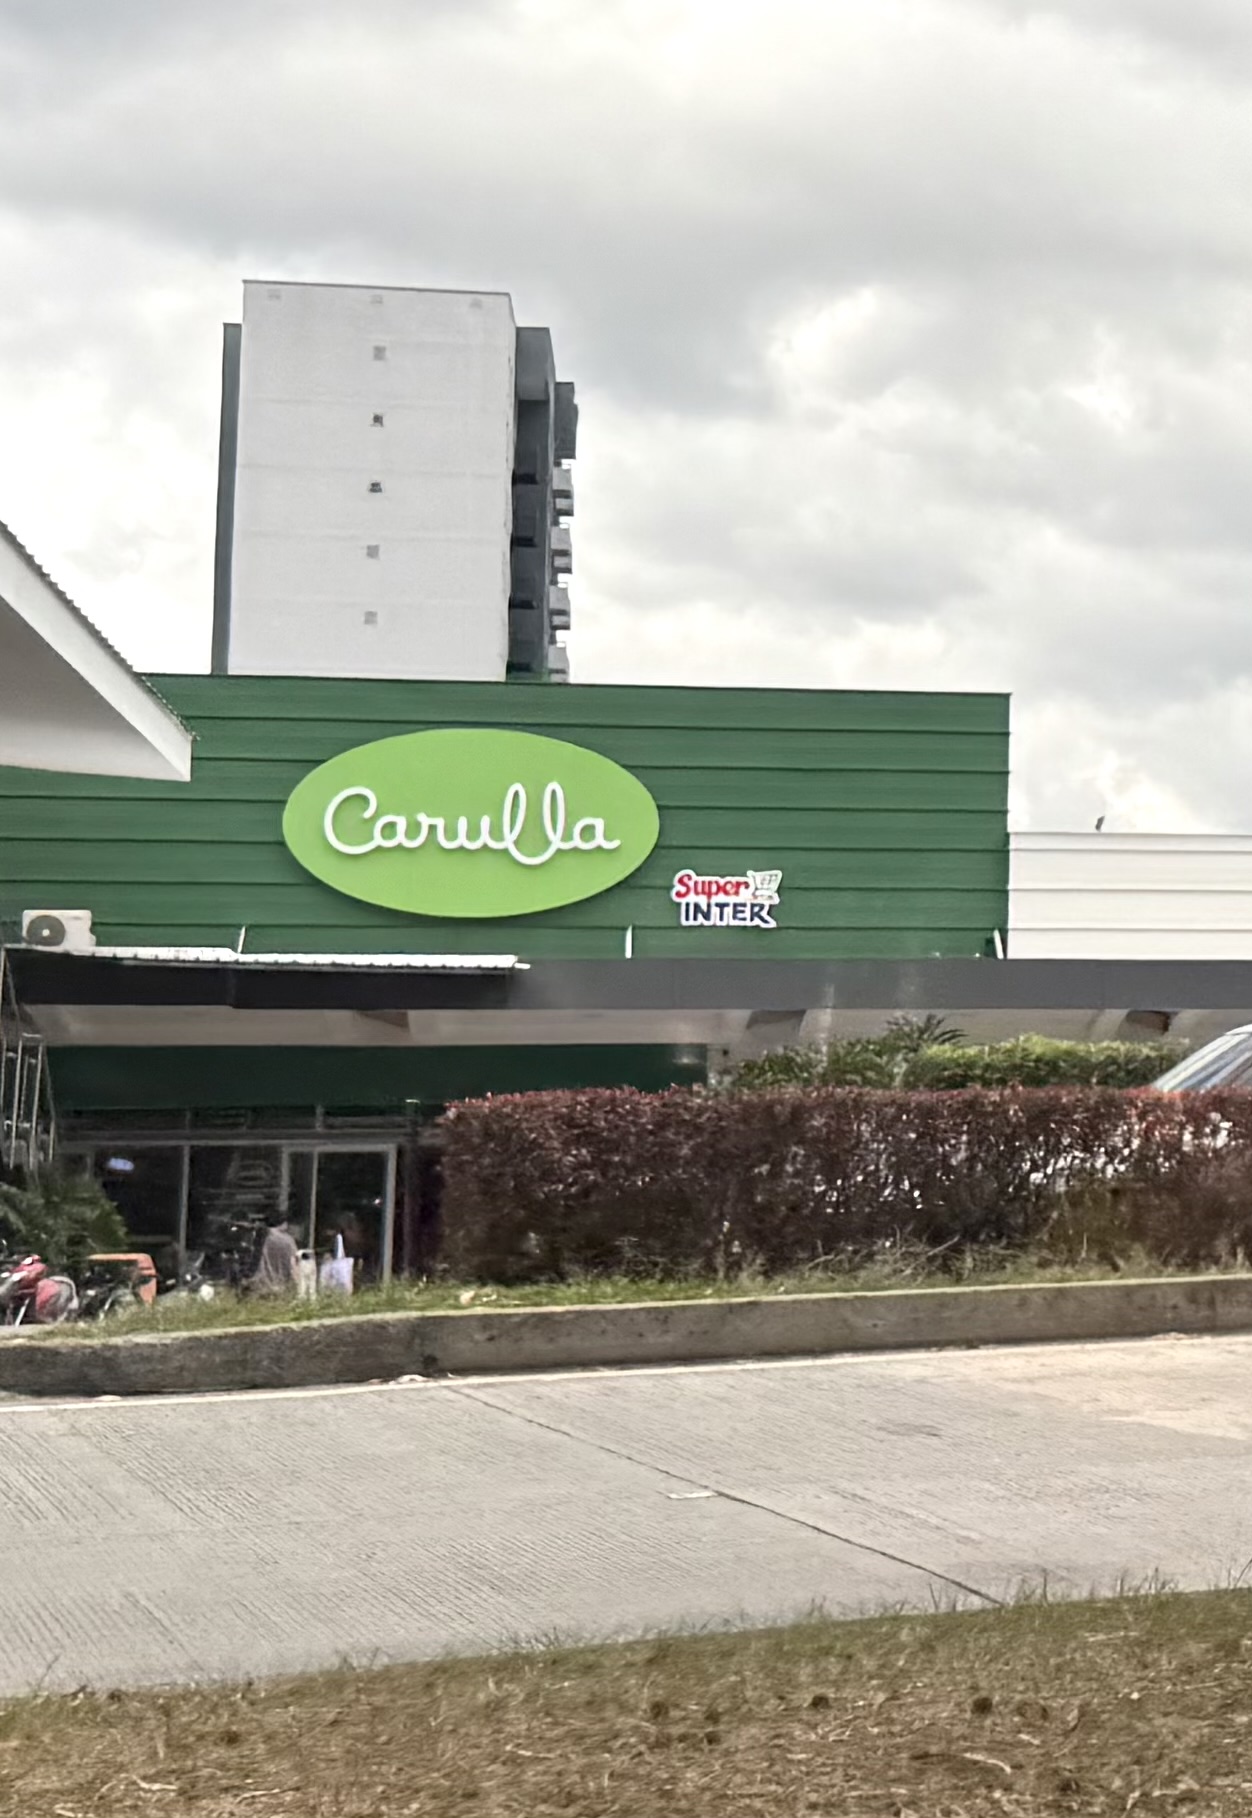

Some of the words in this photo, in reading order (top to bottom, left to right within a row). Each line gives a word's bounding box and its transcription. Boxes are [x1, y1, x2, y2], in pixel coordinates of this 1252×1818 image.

[323, 781, 622, 865] Carulla
[675, 874, 750, 901] Super
[685, 902, 770, 924] INTER
